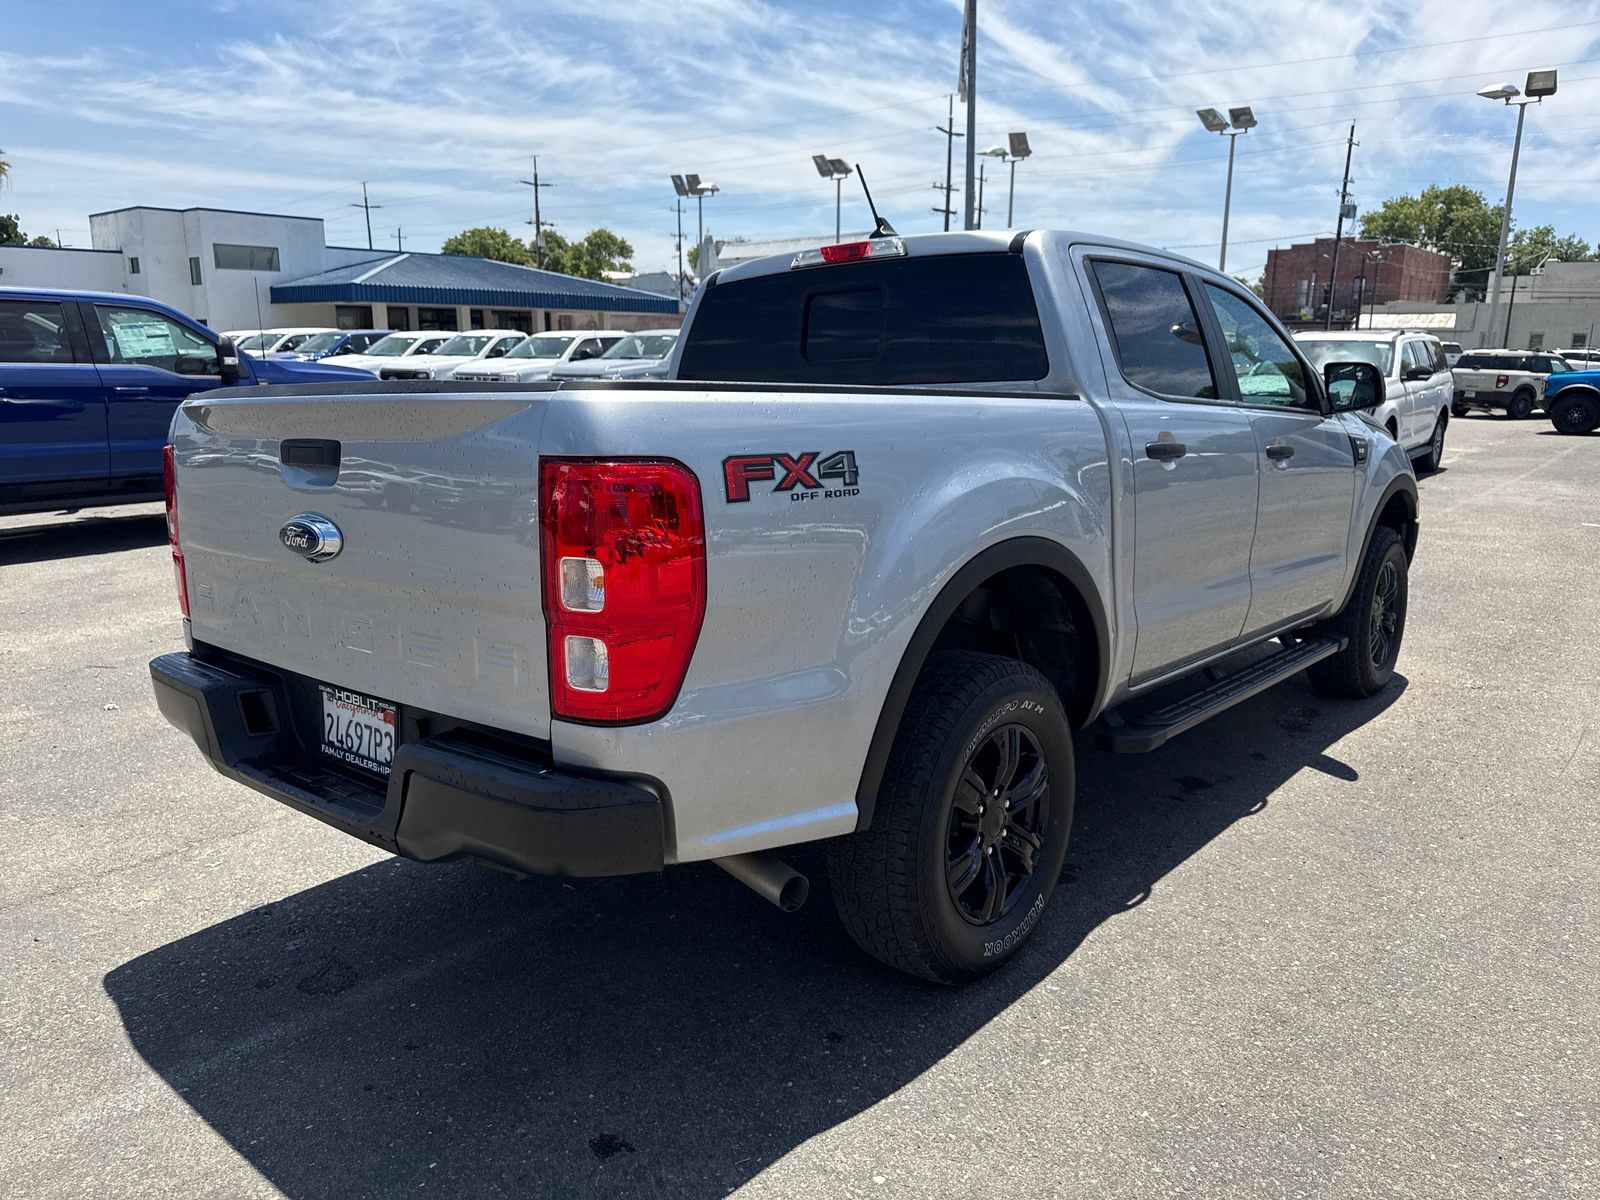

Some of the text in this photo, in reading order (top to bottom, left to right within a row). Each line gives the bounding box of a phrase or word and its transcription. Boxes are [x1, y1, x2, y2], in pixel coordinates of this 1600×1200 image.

[722, 450, 859, 503] FX4
[791, 488, 860, 501] OFF ROAD
[284, 526, 309, 548] Ford
[191, 576, 531, 690] RANGER
[335, 689, 378, 710] HOBLIT
[326, 712, 393, 765] 24697P3
[321, 744, 344, 760] FAMILY
